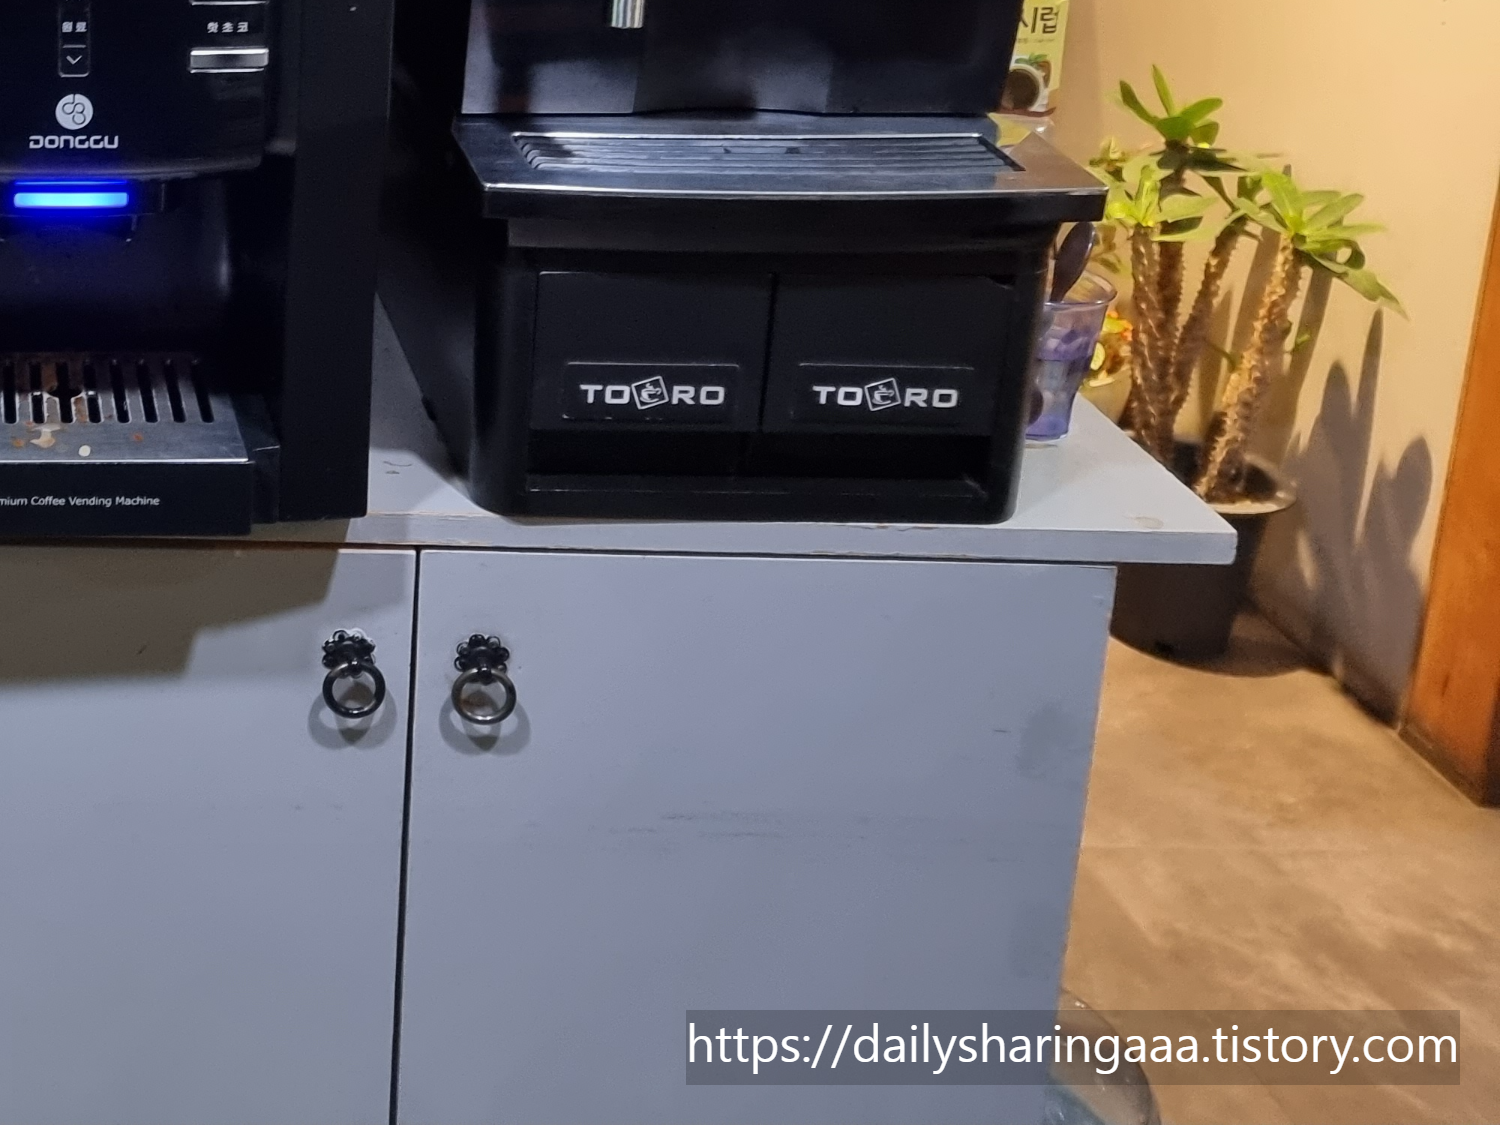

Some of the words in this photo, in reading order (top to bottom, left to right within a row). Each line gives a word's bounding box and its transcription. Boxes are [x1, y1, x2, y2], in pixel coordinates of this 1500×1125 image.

[28, 135, 119, 149] DONGGU
[30, 495, 66, 506] Coffee
[68, 496, 112, 508] Vending
[115, 495, 161, 506] Machine
